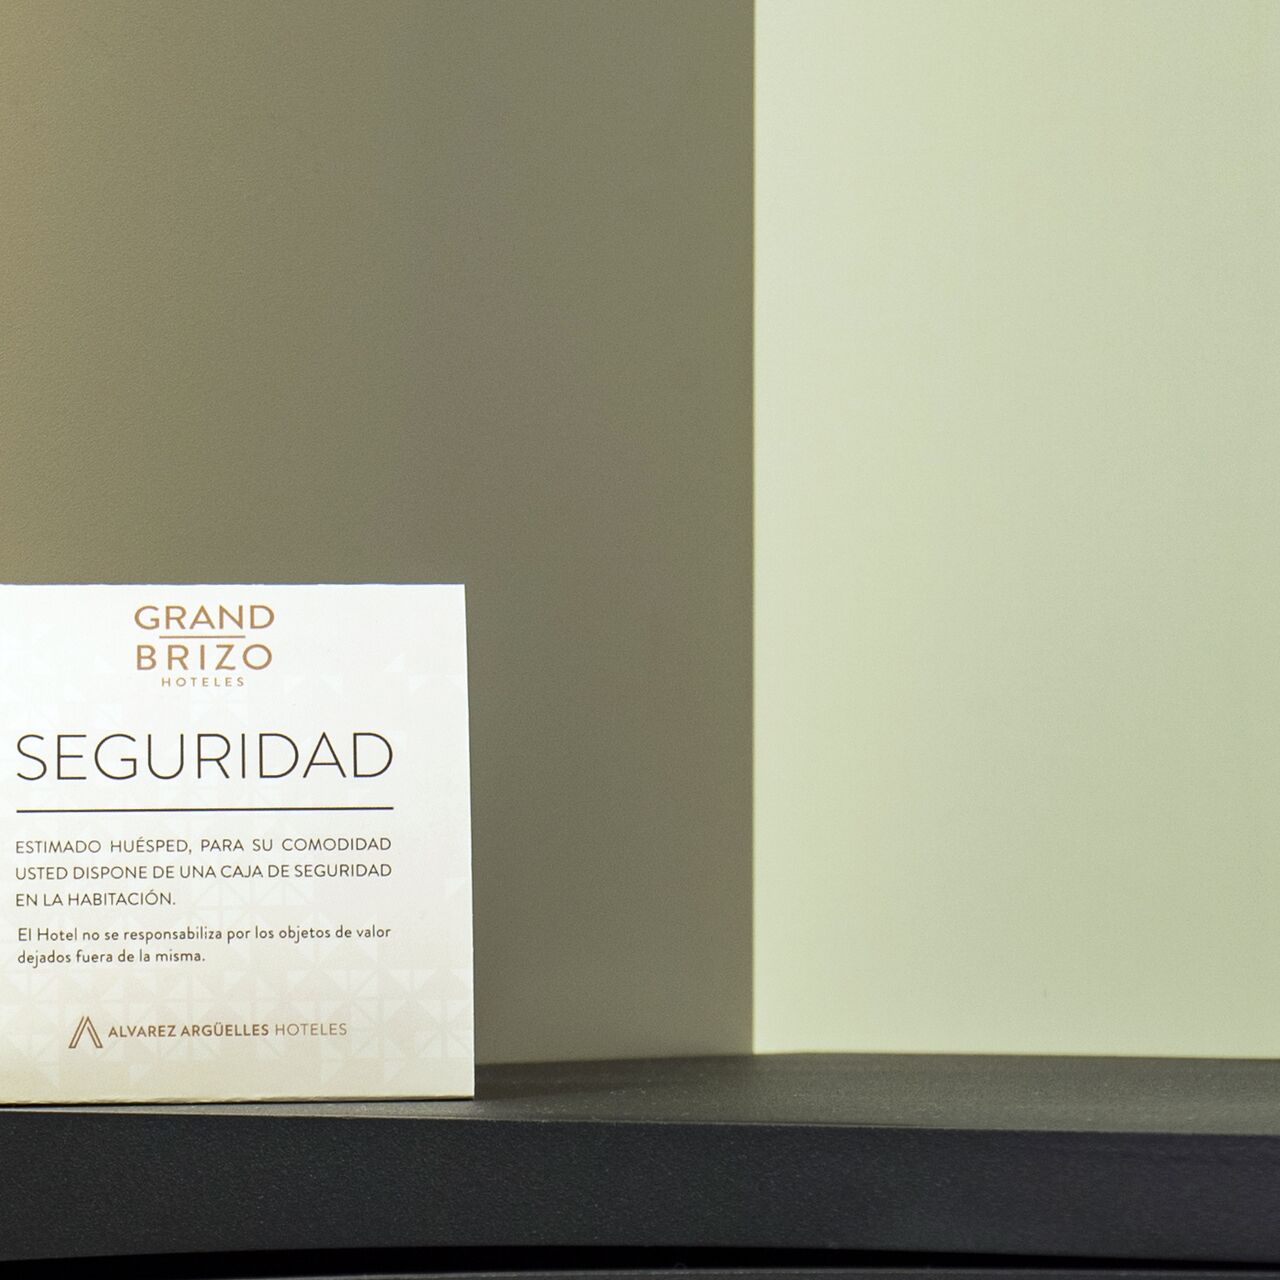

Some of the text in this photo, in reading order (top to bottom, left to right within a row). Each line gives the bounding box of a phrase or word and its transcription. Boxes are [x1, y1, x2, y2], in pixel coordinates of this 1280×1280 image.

[133, 604, 275, 631] GRAND
[136, 643, 273, 671] BRIZO
[161, 676, 245, 688] HOTELES
[16, 731, 394, 782] SEGURIDAD
[15, 836, 392, 855] ESTIMADO HUÉSPED, PARA SU COMODIDAD
[15, 863, 392, 881] USTED DISPONE DE UNA CAJA DE SEGURIDAD
[15, 888, 176, 907] EN LA HABITACIÓN.
[18, 924, 392, 945] El Hotel no se responsabiliza por los objetos de valor
[17, 948, 206, 969] dejados fuera de la misma.
[107, 1021, 348, 1038] ALVAREZ ARGÜELLES HOTELES
